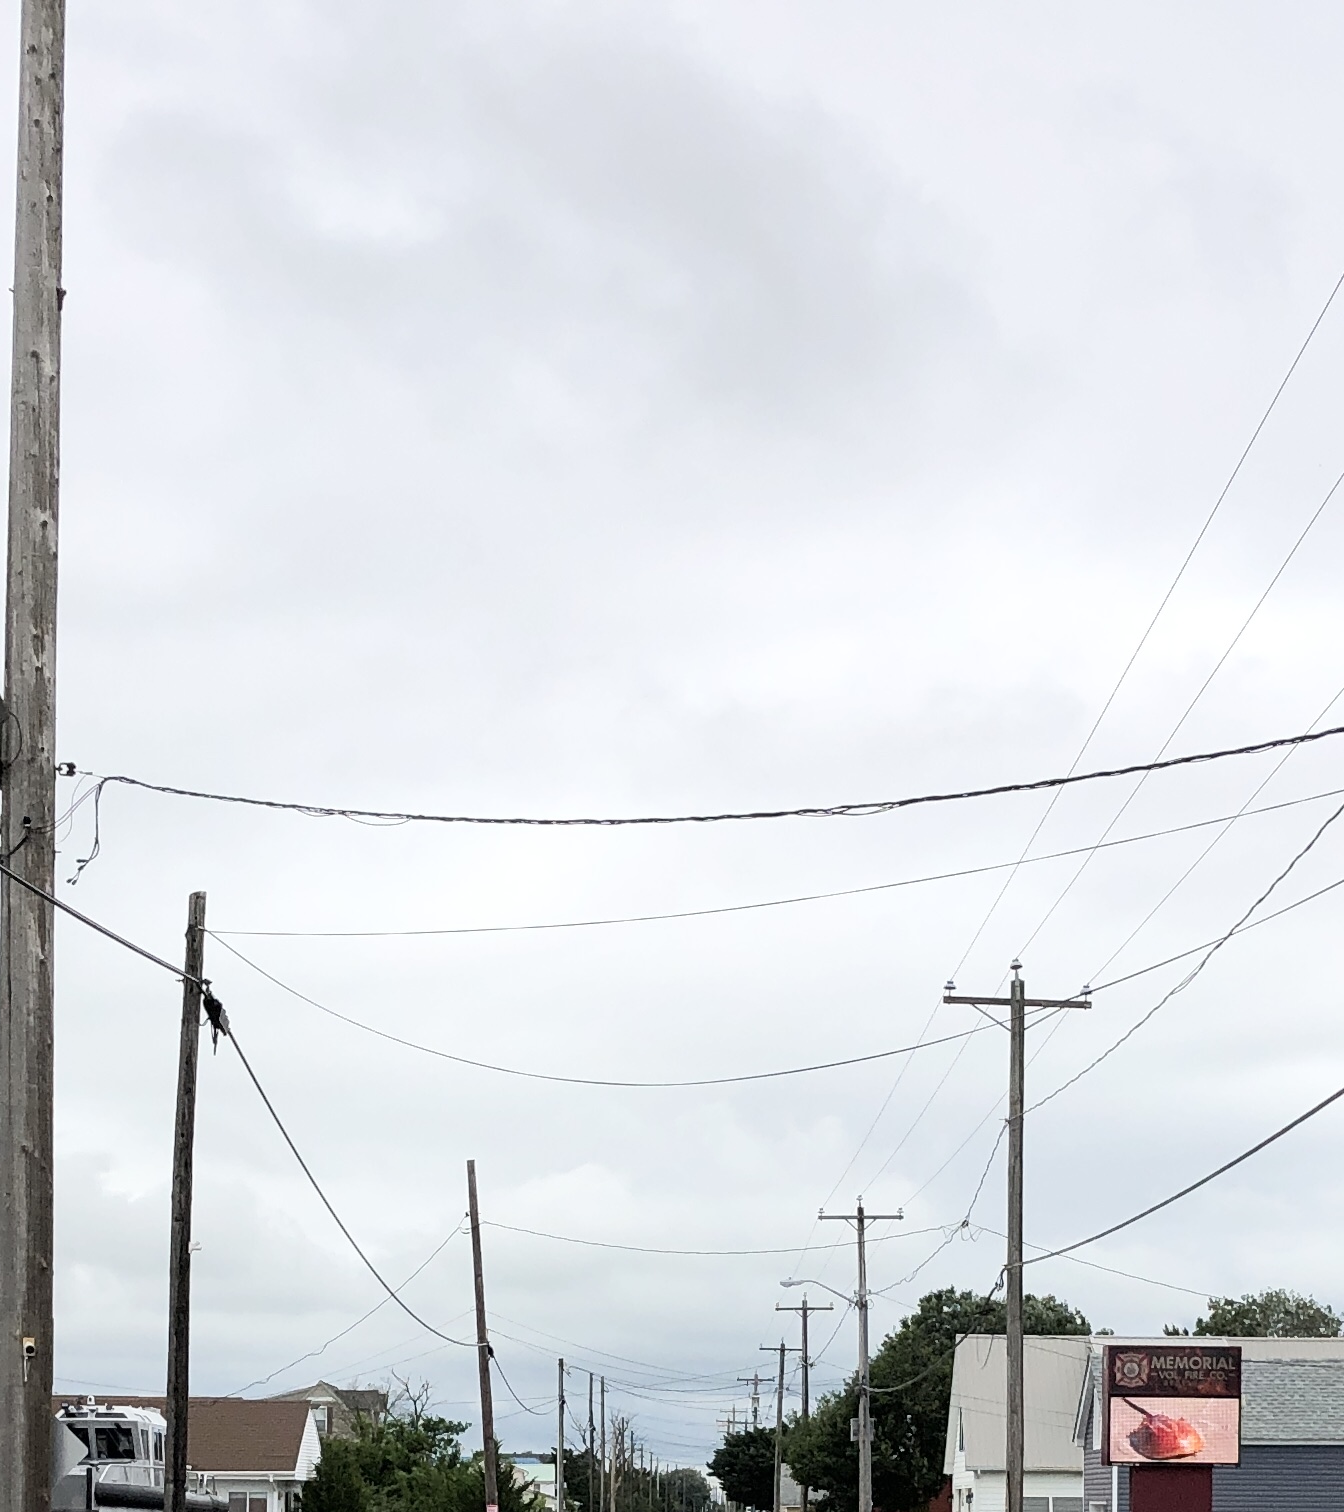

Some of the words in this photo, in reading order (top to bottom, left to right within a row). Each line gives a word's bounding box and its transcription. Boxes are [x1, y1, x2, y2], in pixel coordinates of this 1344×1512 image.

[1150, 1355, 1236, 1370] MEMORIAL
[1184, 1370, 1206, 1380] FIRE
[1209, 1370, 1228, 1380] CO.
